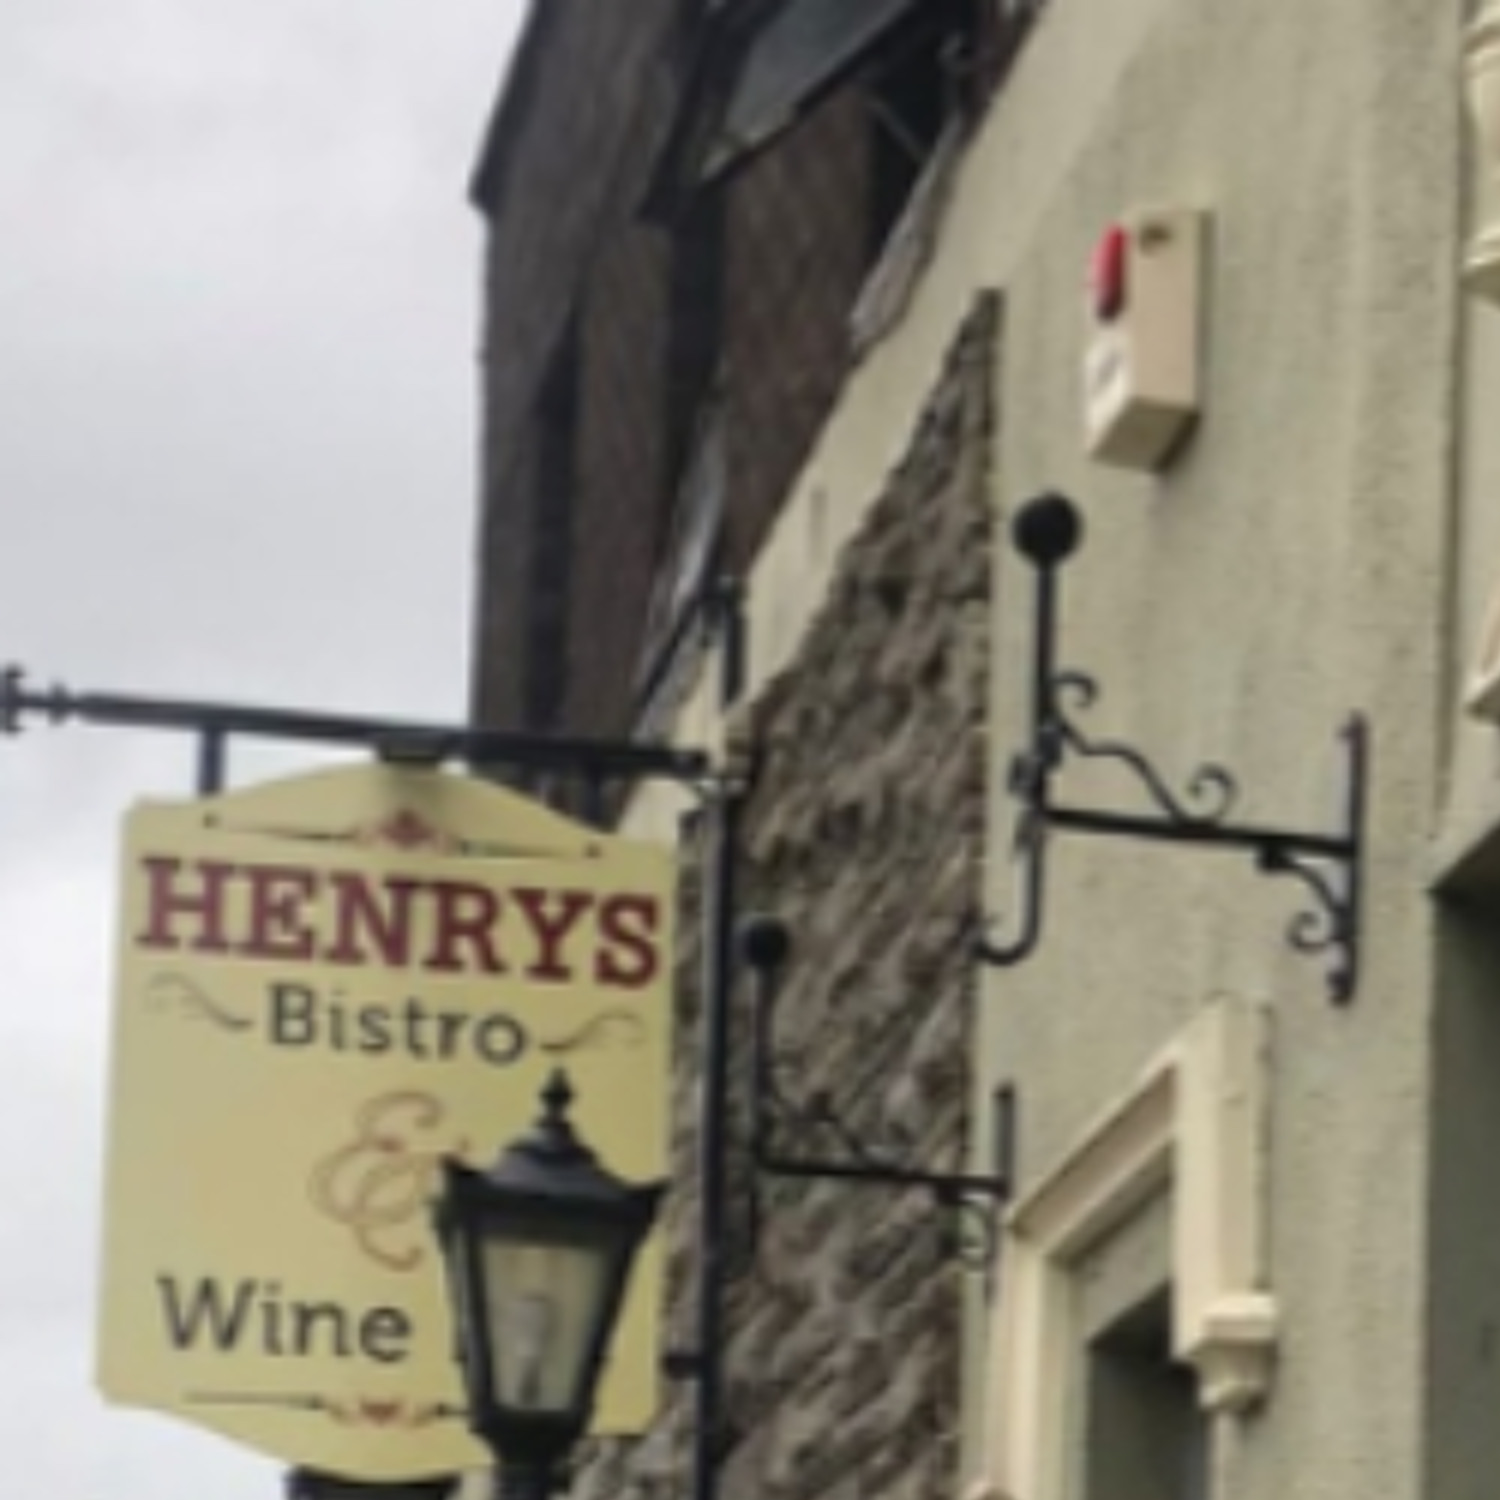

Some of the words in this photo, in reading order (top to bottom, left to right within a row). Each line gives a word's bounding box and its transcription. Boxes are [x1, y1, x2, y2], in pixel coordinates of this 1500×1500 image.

[135, 856, 663, 990] HENRYS
[267, 981, 527, 1067] Bistro
[156, 1273, 413, 1364] Wine
